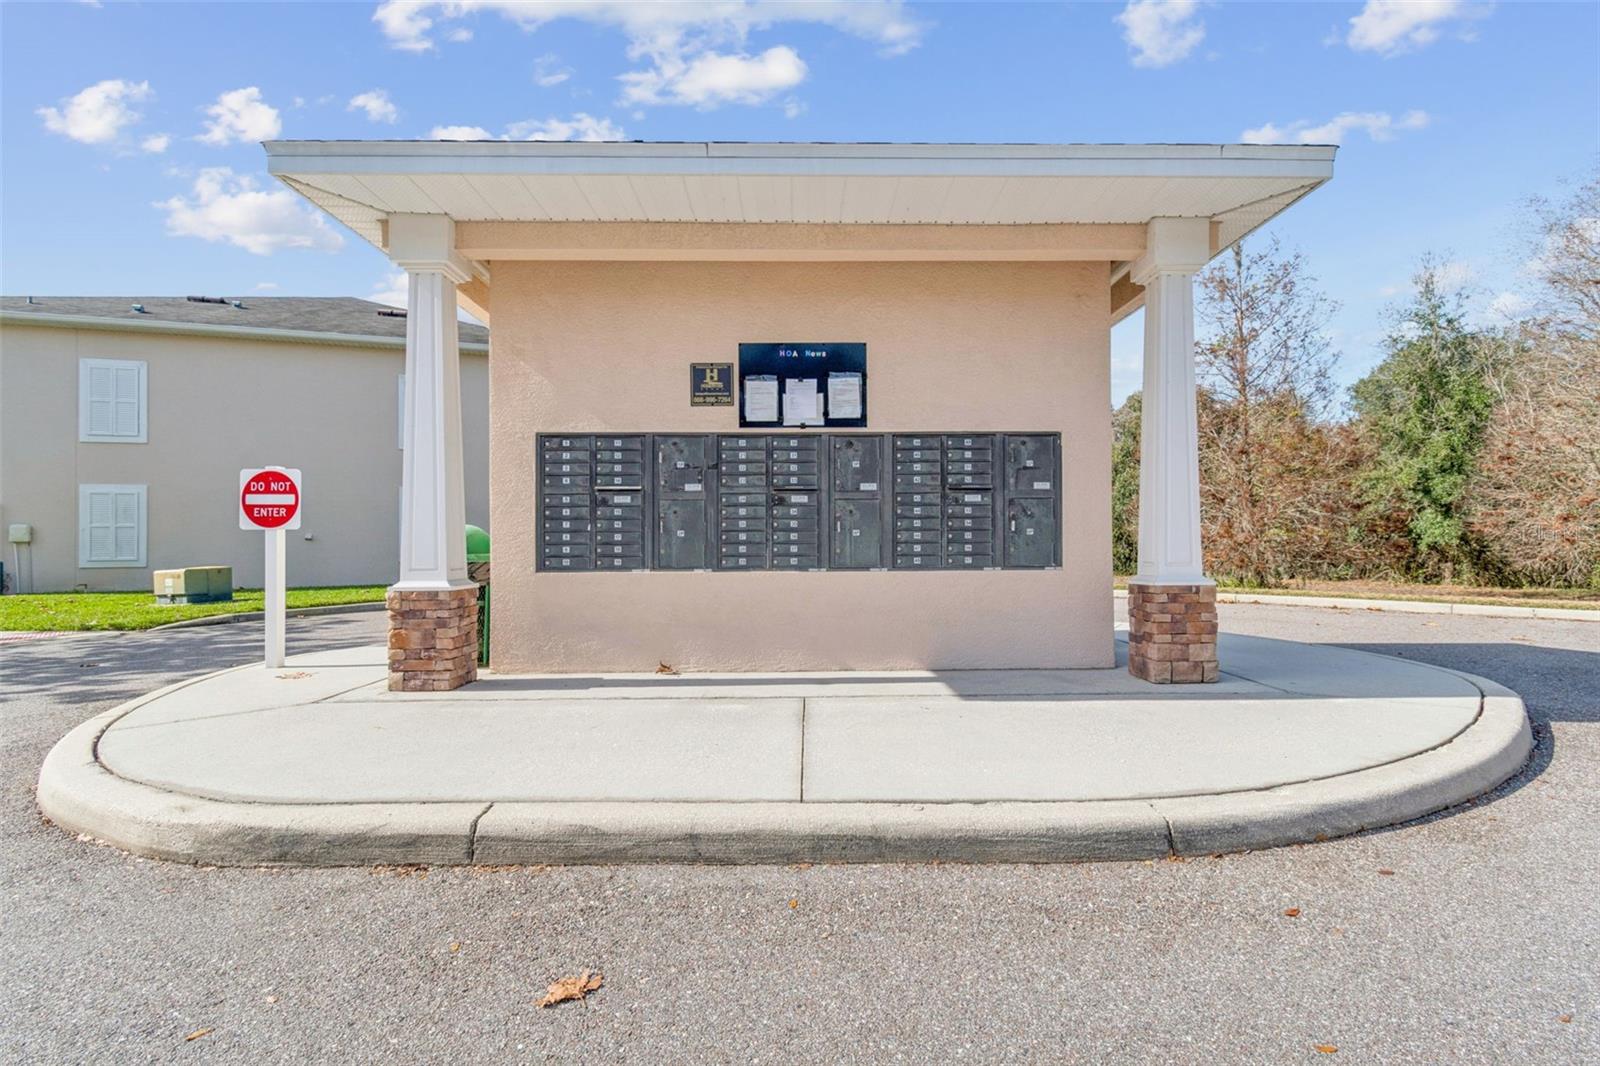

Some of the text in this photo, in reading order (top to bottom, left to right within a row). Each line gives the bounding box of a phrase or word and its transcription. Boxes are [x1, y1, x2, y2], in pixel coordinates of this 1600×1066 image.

[779, 350, 827, 358] HOA News
[250, 481, 291, 491] DO NOT
[253, 507, 287, 517] ENTER
